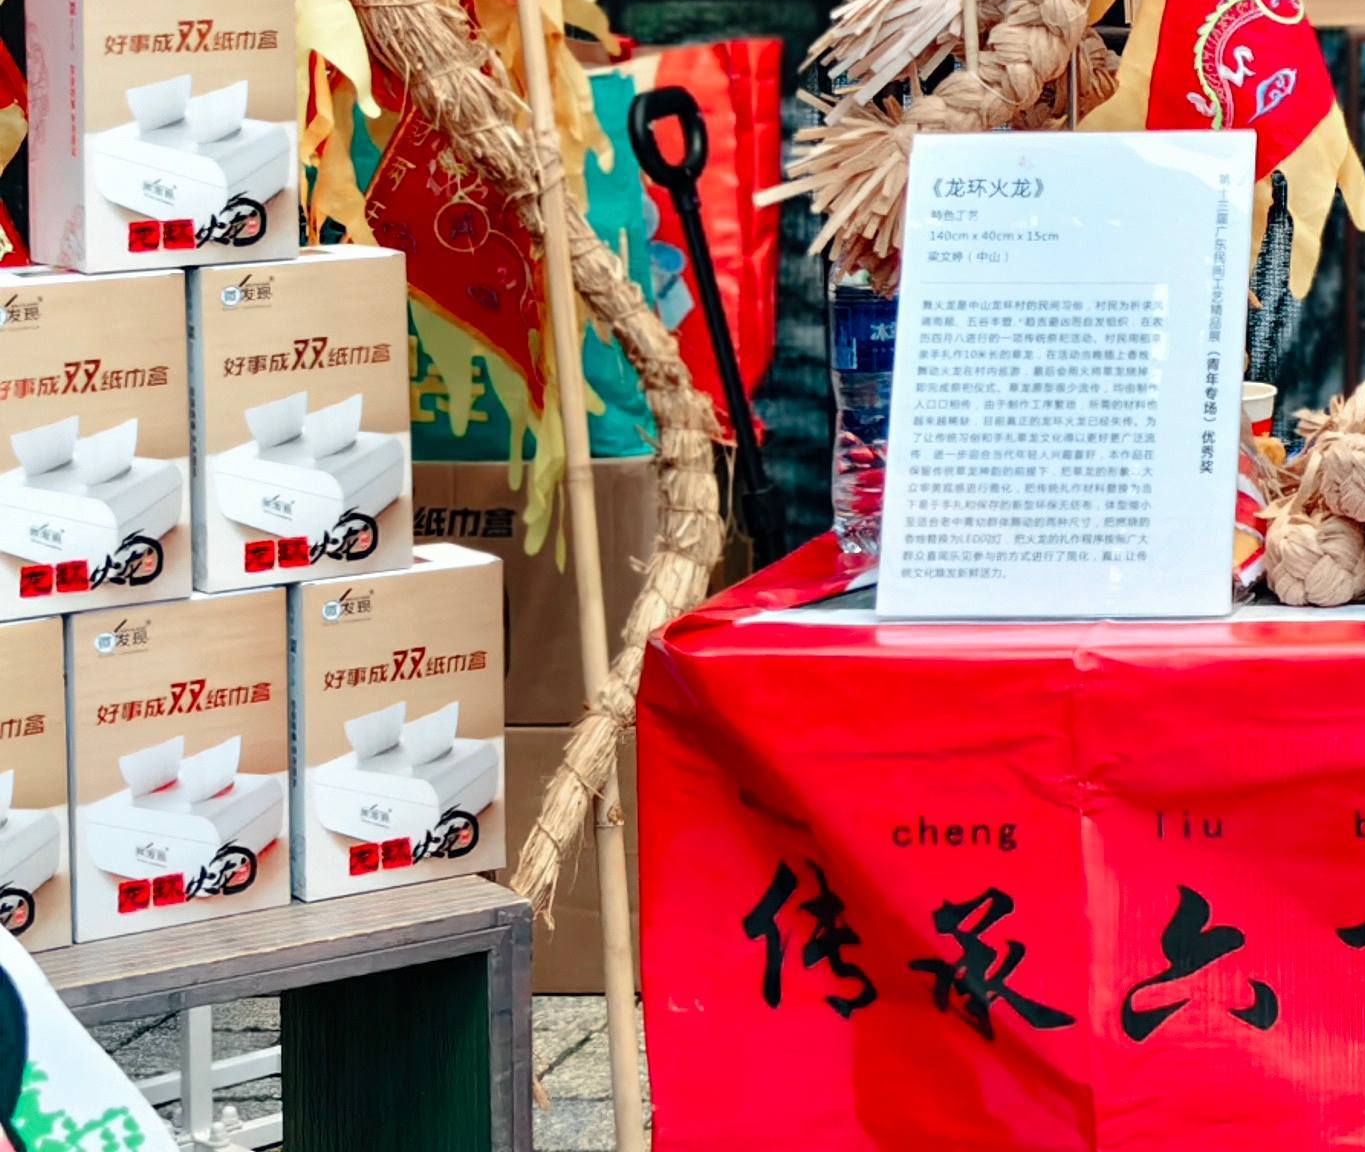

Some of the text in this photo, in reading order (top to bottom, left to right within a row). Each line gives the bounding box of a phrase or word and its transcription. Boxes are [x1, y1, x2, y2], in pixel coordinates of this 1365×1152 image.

[105, 19, 279, 56] 好事成双纸巾盒
[931, 178, 1045, 199] 《龙环火龙》
[930, 230, 969, 242] 140cm
[981, 230, 1014, 242] 40cm
[1028, 230, 1059, 242] 15cm
[0, 303, 41, 325] 发现
[223, 336, 392, 378] 好事成双纸巾盒
[324, 646, 489, 692] 好事成双纸巾盒
[97, 678, 273, 726] 好事成双纸巾盒
[892, 818, 1018, 849] cheng
[1155, 812, 1226, 840] liu
